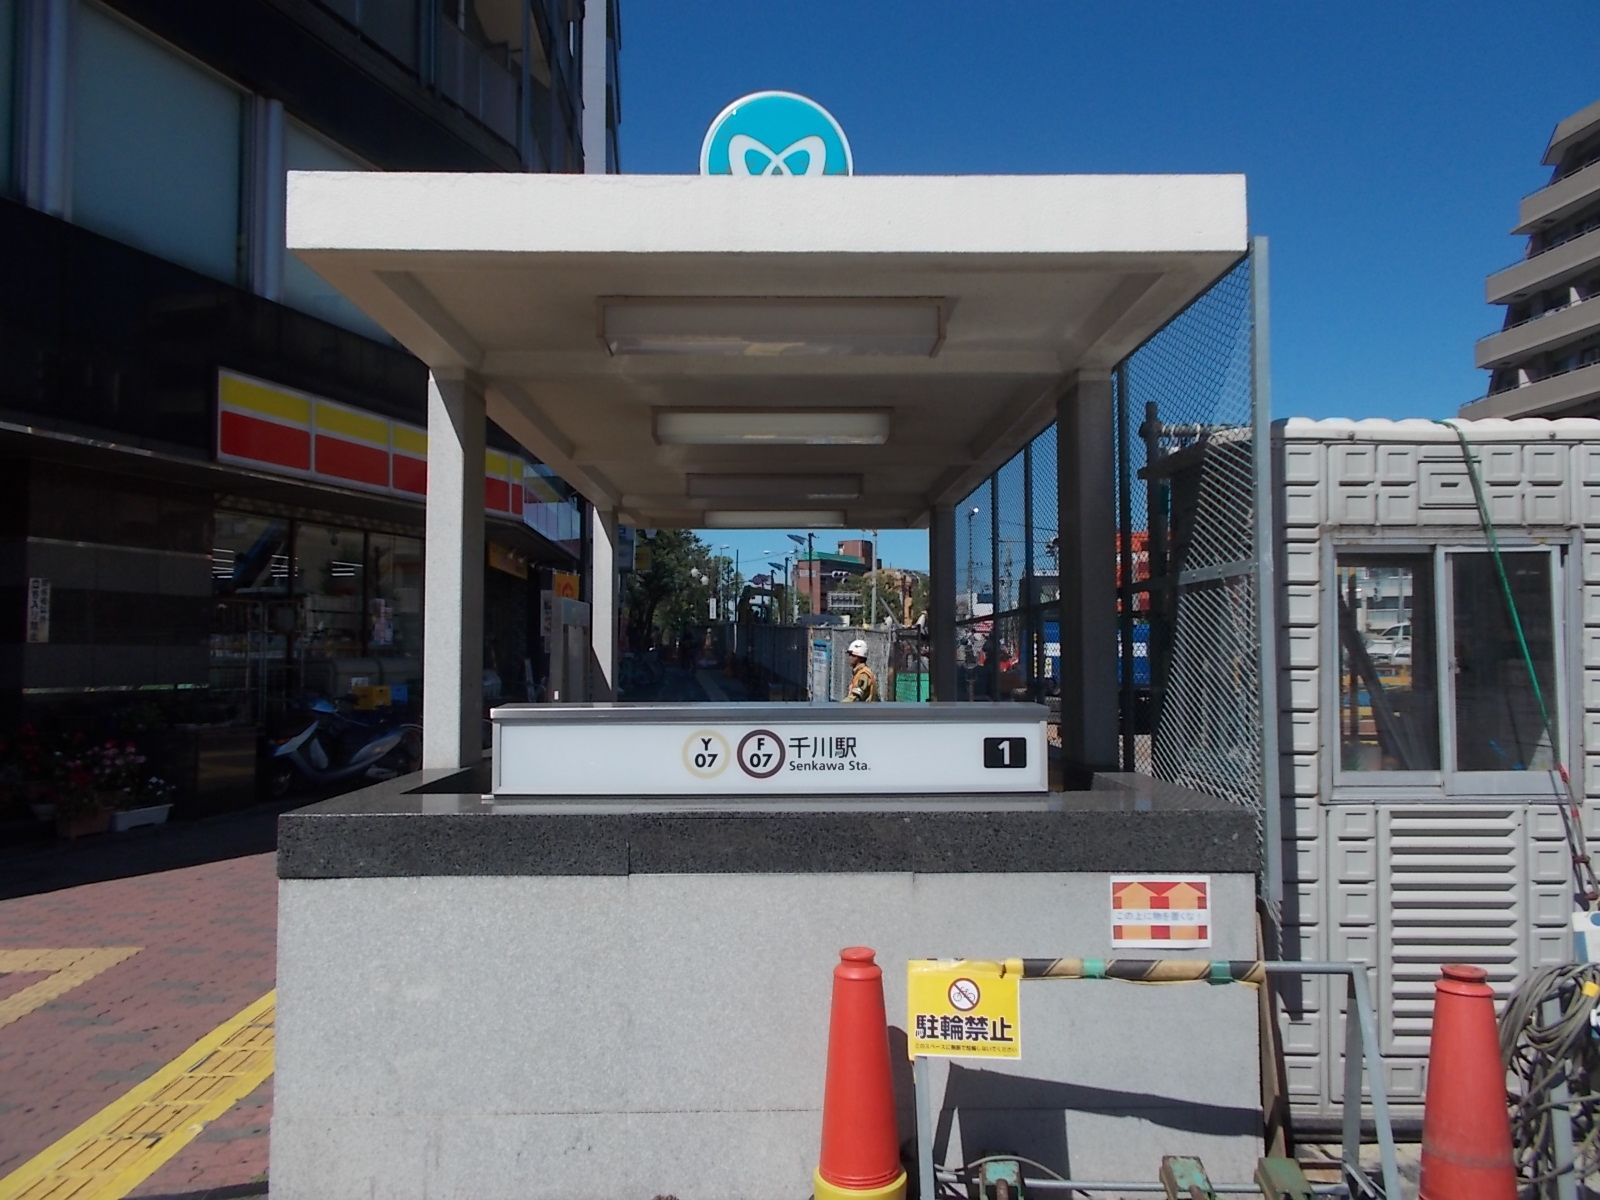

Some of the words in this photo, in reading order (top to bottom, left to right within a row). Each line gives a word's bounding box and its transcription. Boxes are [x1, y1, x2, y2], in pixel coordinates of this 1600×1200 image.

[701, 737, 713, 751] Y
[757, 737, 766, 751] F
[788, 736, 858, 759] 千川駅
[997, 739, 1012, 766] 1
[694, 753, 719, 768] 07
[749, 753, 774, 768] 07
[789, 760, 845, 771] Senkawa
[848, 760, 872, 771] Sta.
[915, 1013, 1014, 1042] 駐輪禁止
